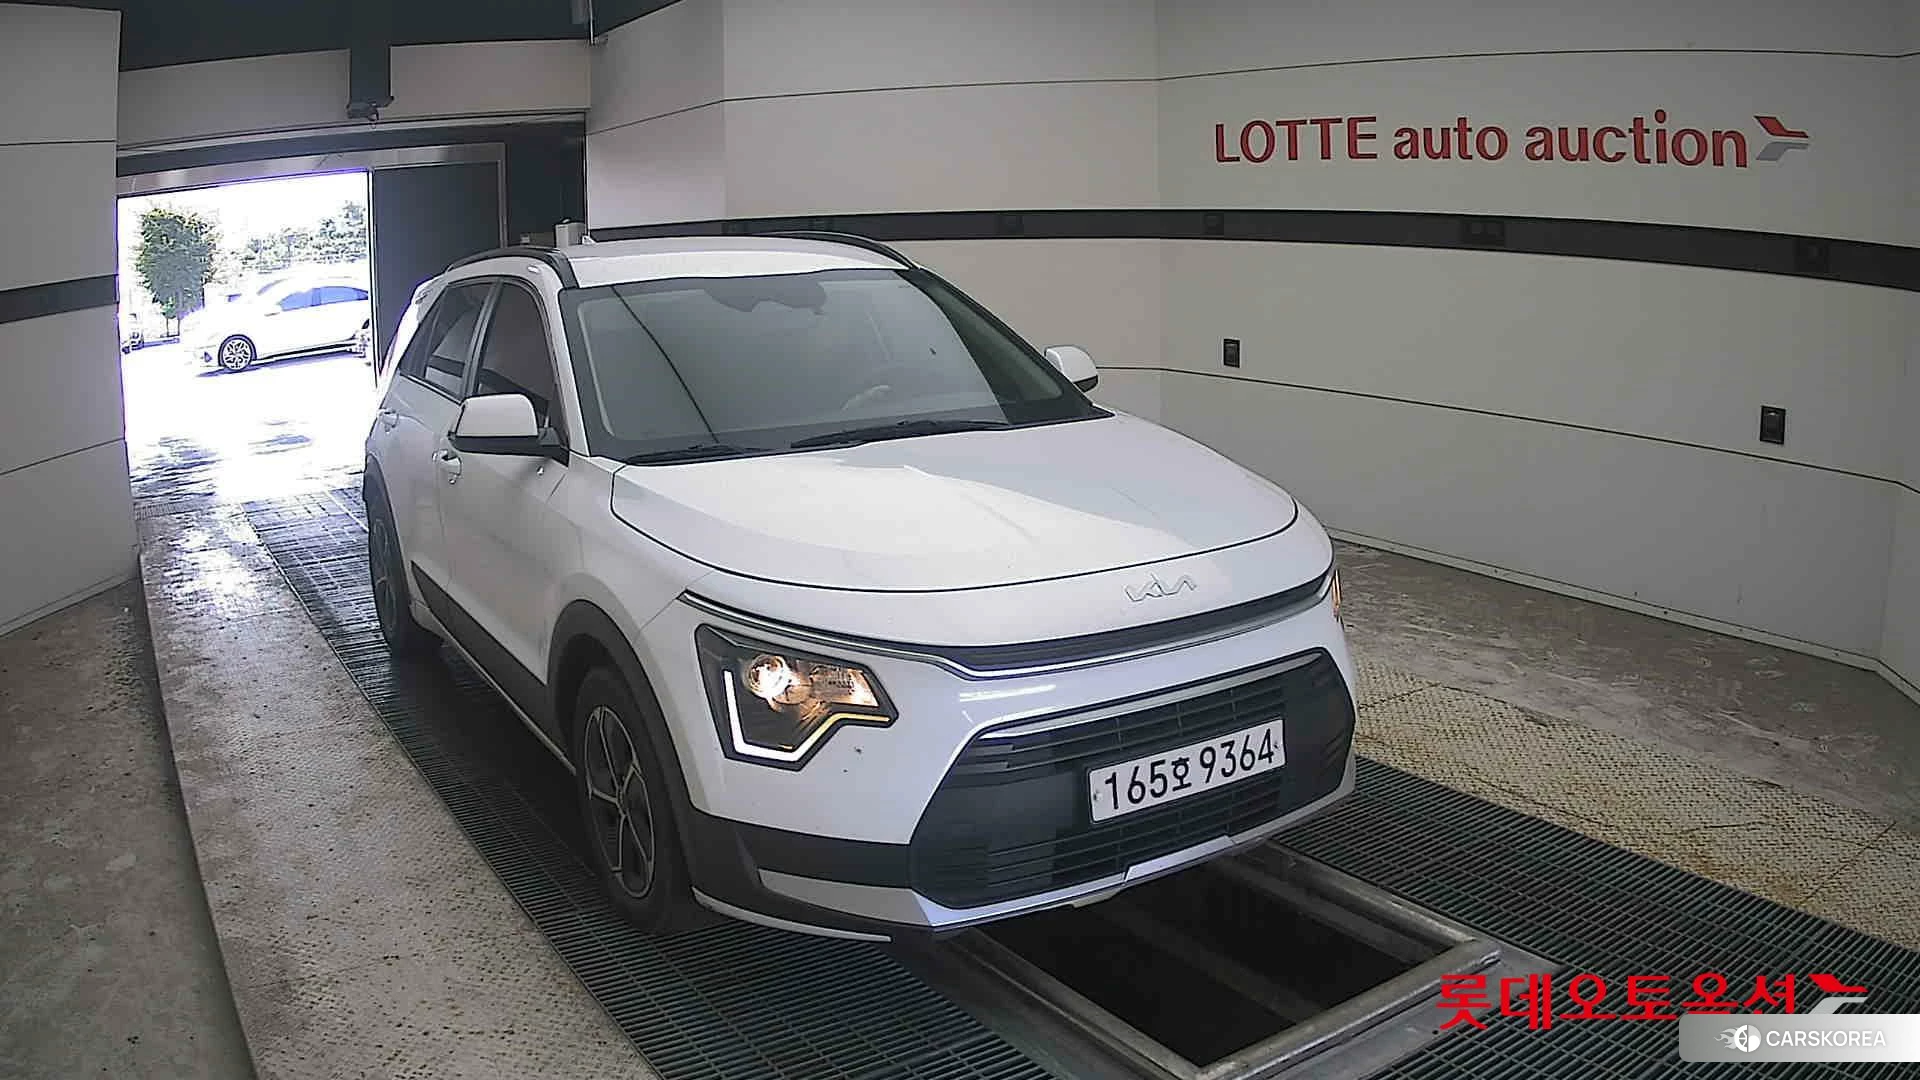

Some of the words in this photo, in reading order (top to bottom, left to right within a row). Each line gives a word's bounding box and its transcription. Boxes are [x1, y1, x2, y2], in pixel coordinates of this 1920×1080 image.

[1214, 117, 1377, 163] LOTTE
[1392, 116, 1508, 161] auto
[1524, 110, 1749, 168] auction
[1105, 757, 1192, 810] 165호
[1200, 728, 1274, 784] 9364
